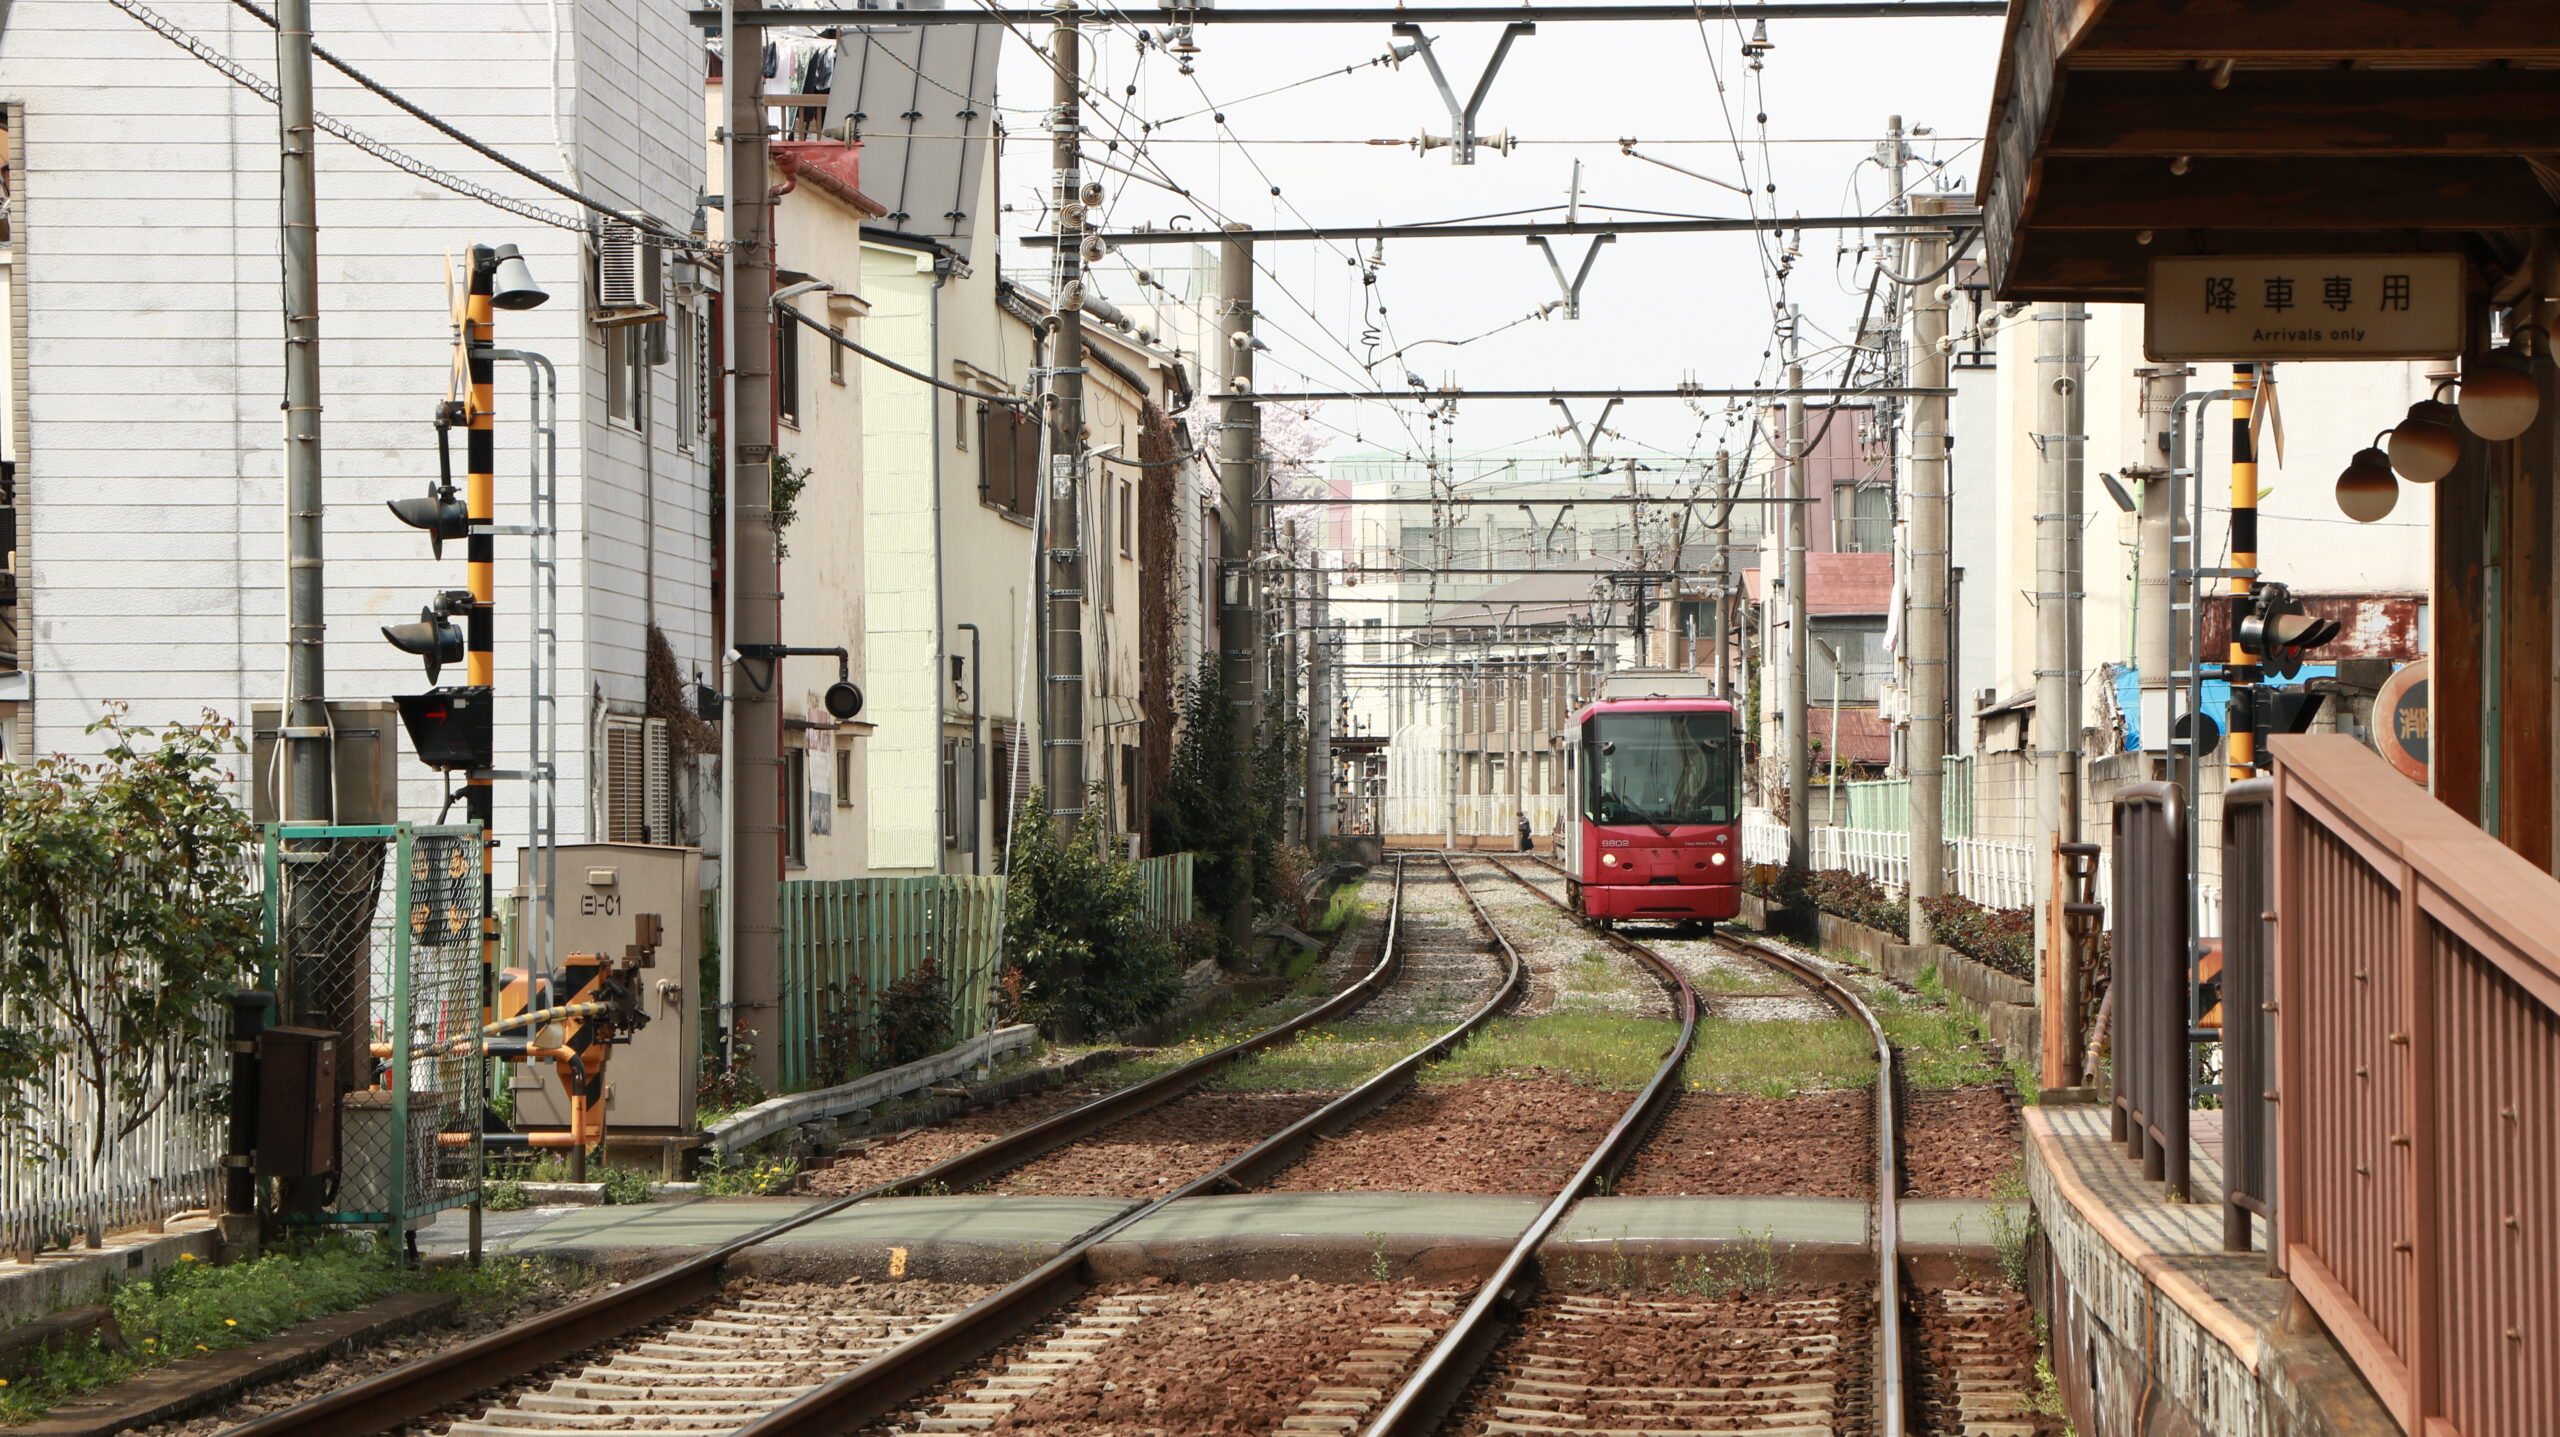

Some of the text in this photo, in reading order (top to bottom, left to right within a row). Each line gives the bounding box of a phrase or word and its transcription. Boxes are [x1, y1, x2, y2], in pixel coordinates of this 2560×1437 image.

[2205, 275, 2410, 314] 降車専用
[2252, 327, 2366, 342] Arrivals only
